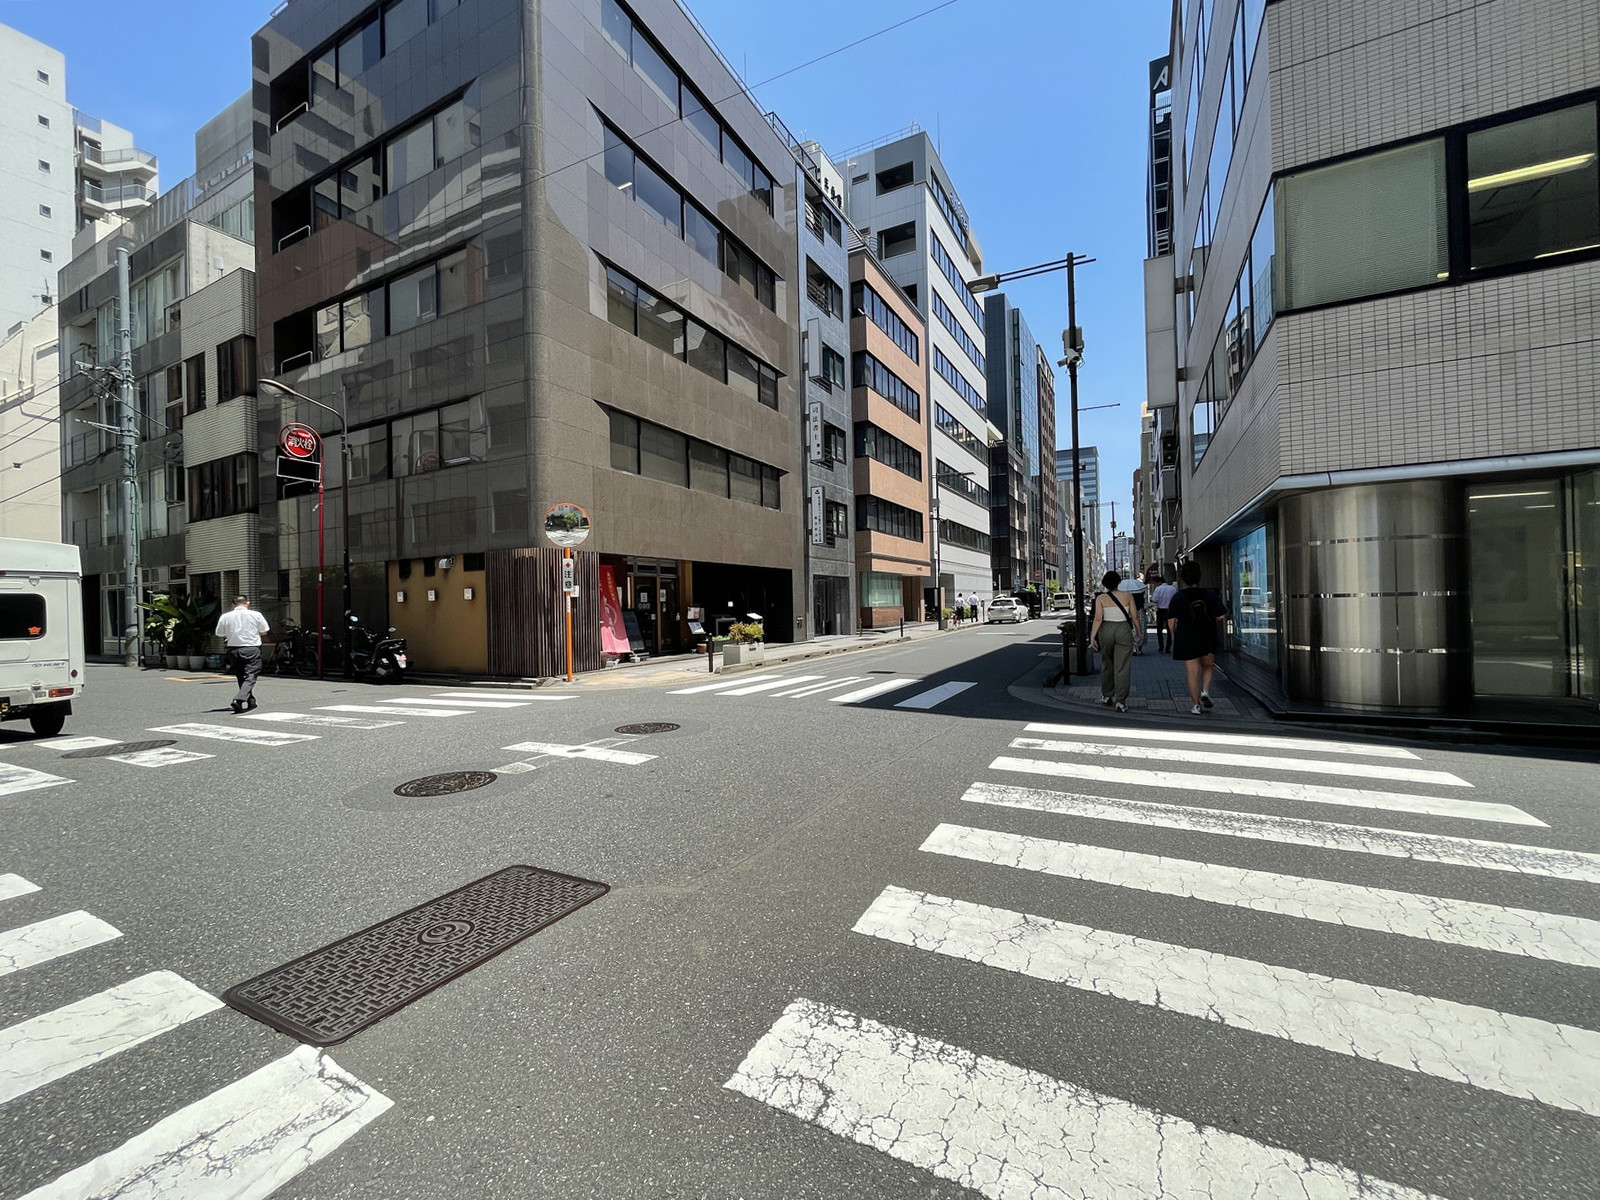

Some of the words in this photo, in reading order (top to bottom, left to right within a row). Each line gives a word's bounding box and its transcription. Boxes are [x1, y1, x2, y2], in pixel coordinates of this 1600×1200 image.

[288, 435, 313, 450] 消火栓
[564, 570, 572, 589] 注意
